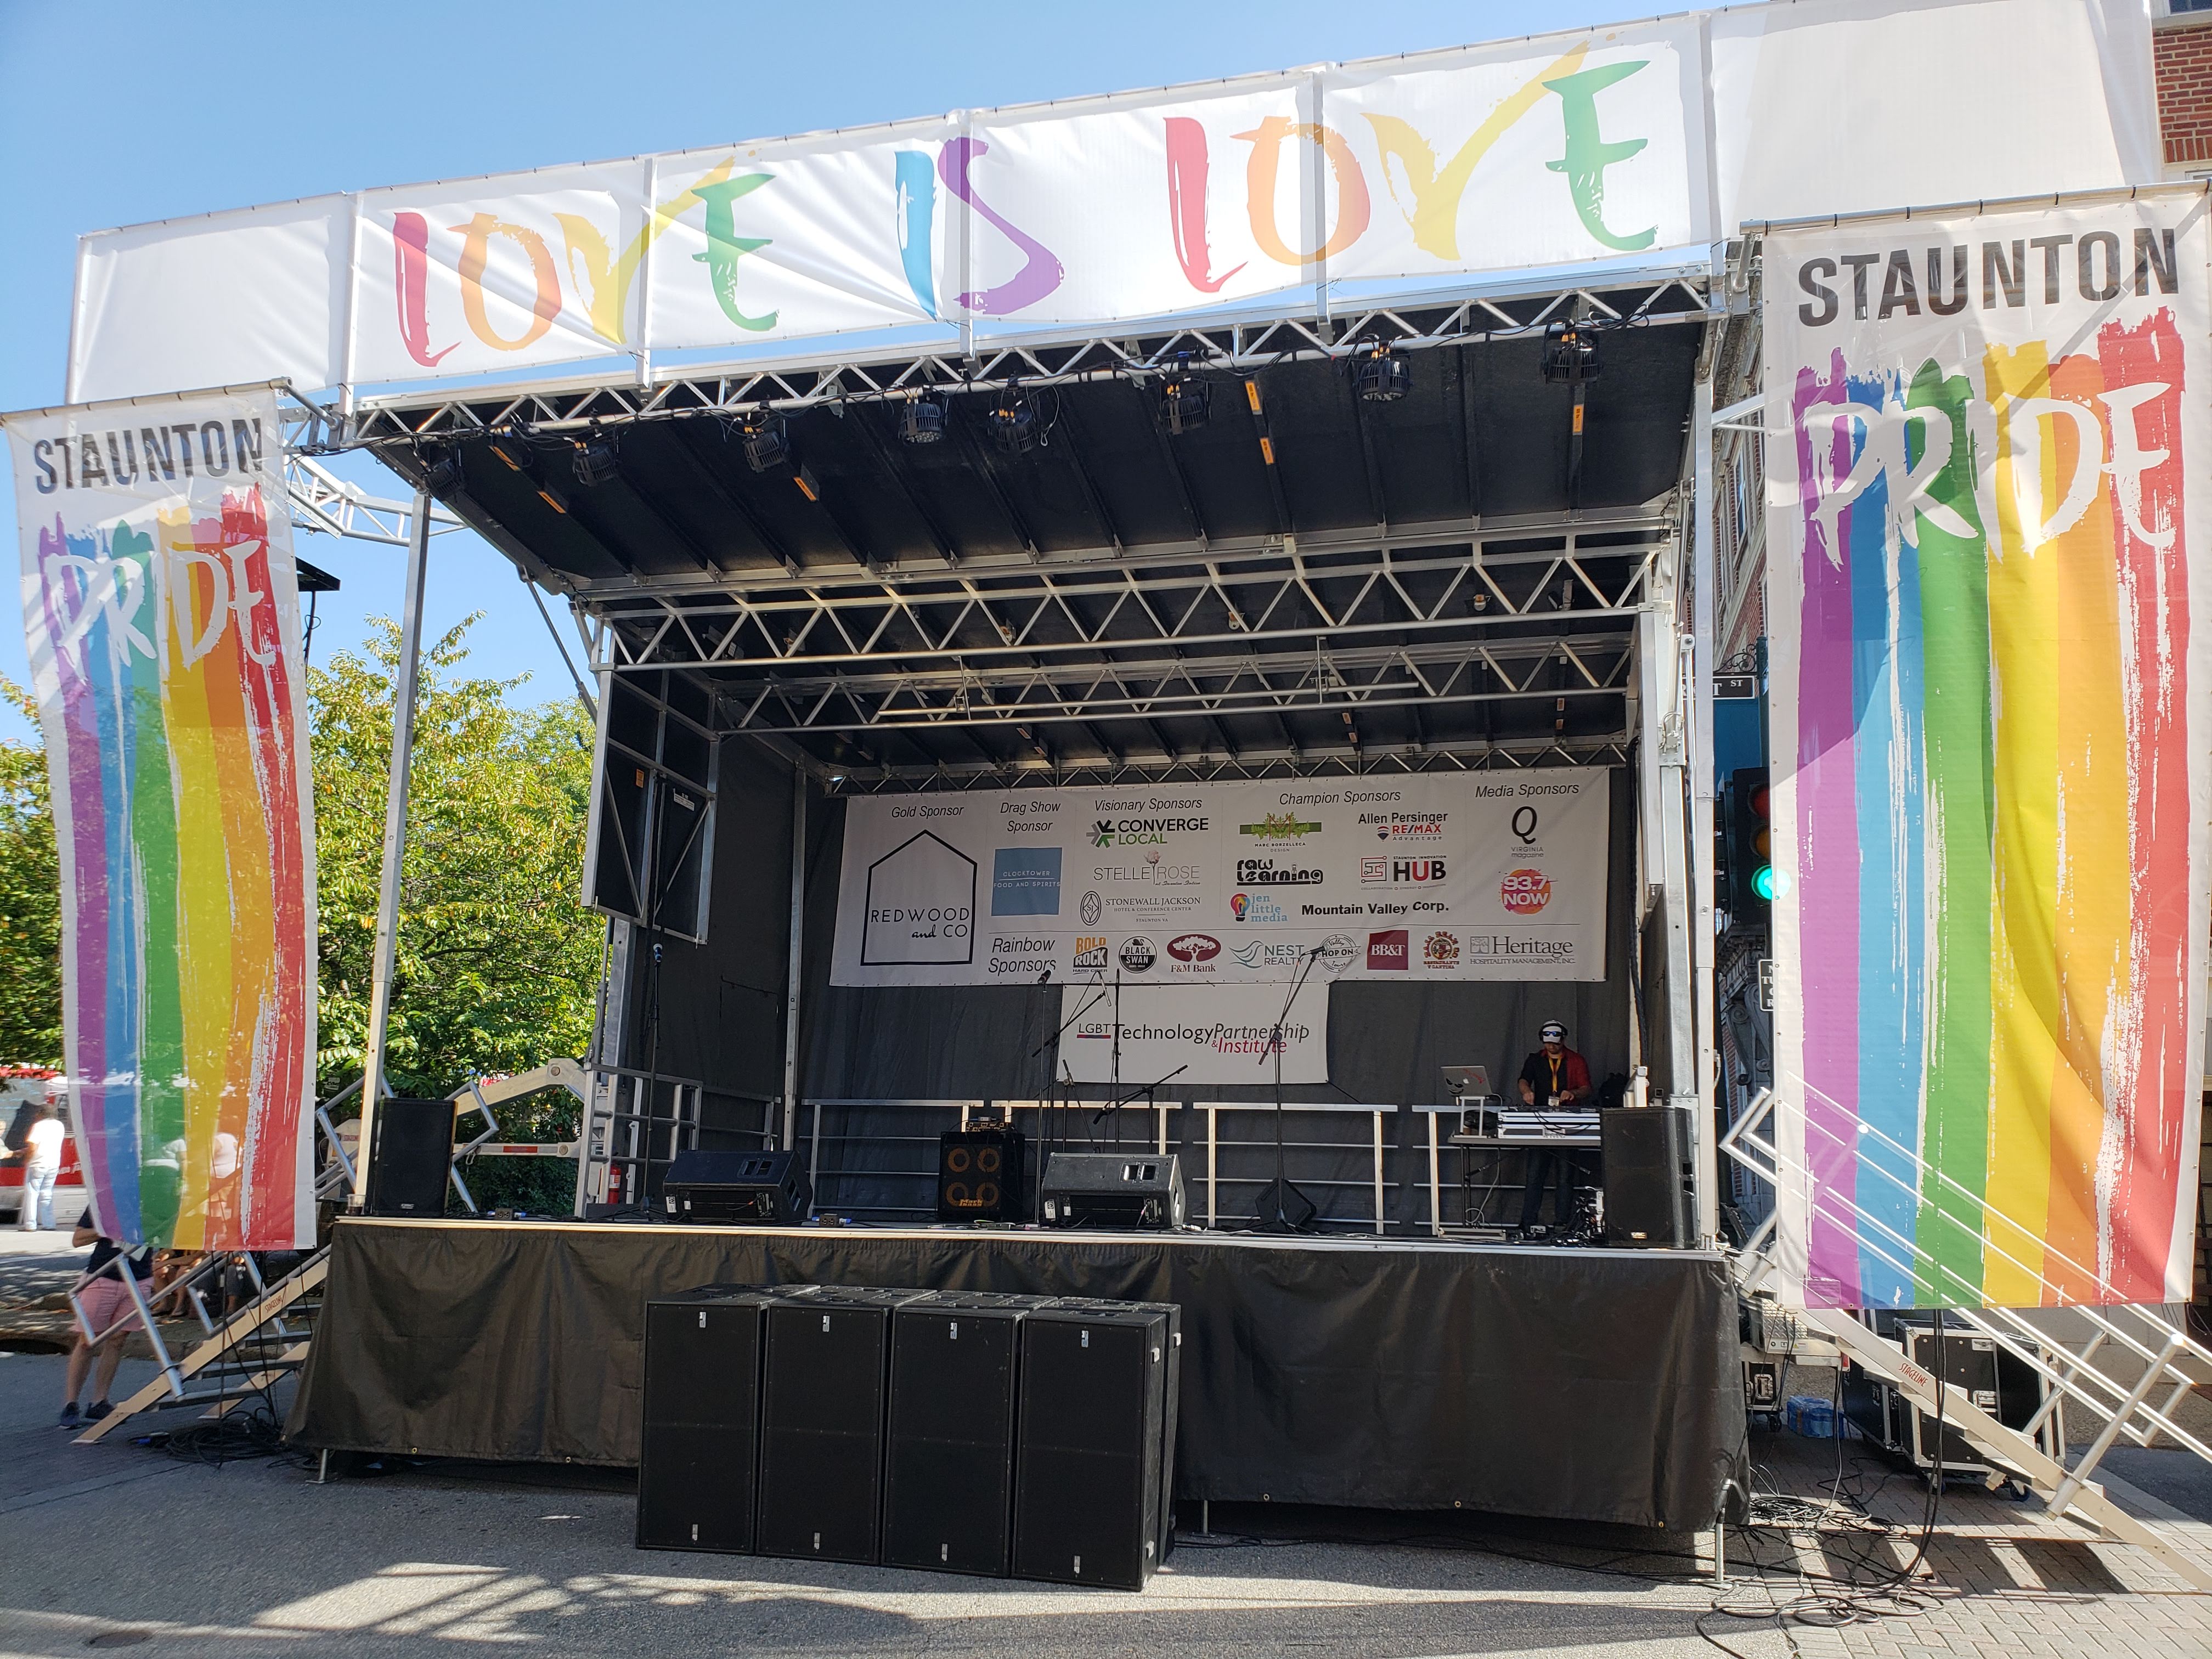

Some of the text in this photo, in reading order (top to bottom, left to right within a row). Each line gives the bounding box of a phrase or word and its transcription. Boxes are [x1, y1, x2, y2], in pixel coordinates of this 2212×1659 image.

[392, 40, 1659, 368] LOVE IS LOVE
[1798, 228, 2180, 327] STAUNTON
[34, 417, 262, 494] STAUNTON
[1803, 382, 2175, 572] PRIDE
[44, 540, 276, 686] PRIDE
[1475, 784, 1579, 798] Media Sponsors
[1095, 798, 1202, 812] Visionary Sponsors
[1280, 791, 1401, 806] Champion Sponsors
[891, 805, 964, 819] Gold Sponsor
[1001, 802, 1061, 815] Drag Show
[1118, 818, 1209, 832] CONVERGE
[1358, 812, 1448, 824] Allen Persinger
[1511, 806, 1537, 844] Q
[1007, 821, 1053, 834] Sponsor
[1392, 824, 1441, 834] RE/MAX
[1119, 833, 1167, 845] LOCAL
[1093, 866, 1200, 880] STELLE ROSE
[1393, 861, 1446, 881] HUB
[1503, 876, 1548, 890] 93.7
[1161, 897, 1201, 906] JACKSON
[1251, 894, 1270, 904] jen
[1504, 893, 1549, 905] NOW
[1087, 905, 1093, 913] SJ
[1251, 905, 1280, 913] little
[1302, 901, 1449, 915] Mountain Valley Corp.
[871, 908, 969, 923] REDWOOD
[1250, 913, 1288, 922] media
[912, 924, 968, 938] and CO
[992, 937, 1055, 953] Rainbow
[1076, 937, 1107, 955] BOLD
[1265, 945, 1305, 956] NEST
[1371, 944, 1405, 956] BB&T
[1492, 936, 1573, 958] Heritage
[1075, 949, 1107, 966] ROCK
[1126, 956, 1148, 964] SWAN
[1264, 957, 1304, 966] REALTY
[988, 958, 1057, 976] Sponsors
[1193, 964, 1216, 972] Bank
[1079, 1023, 1111, 1034] LGBT
[1898, 1363, 1928, 1387] STAGELINE
